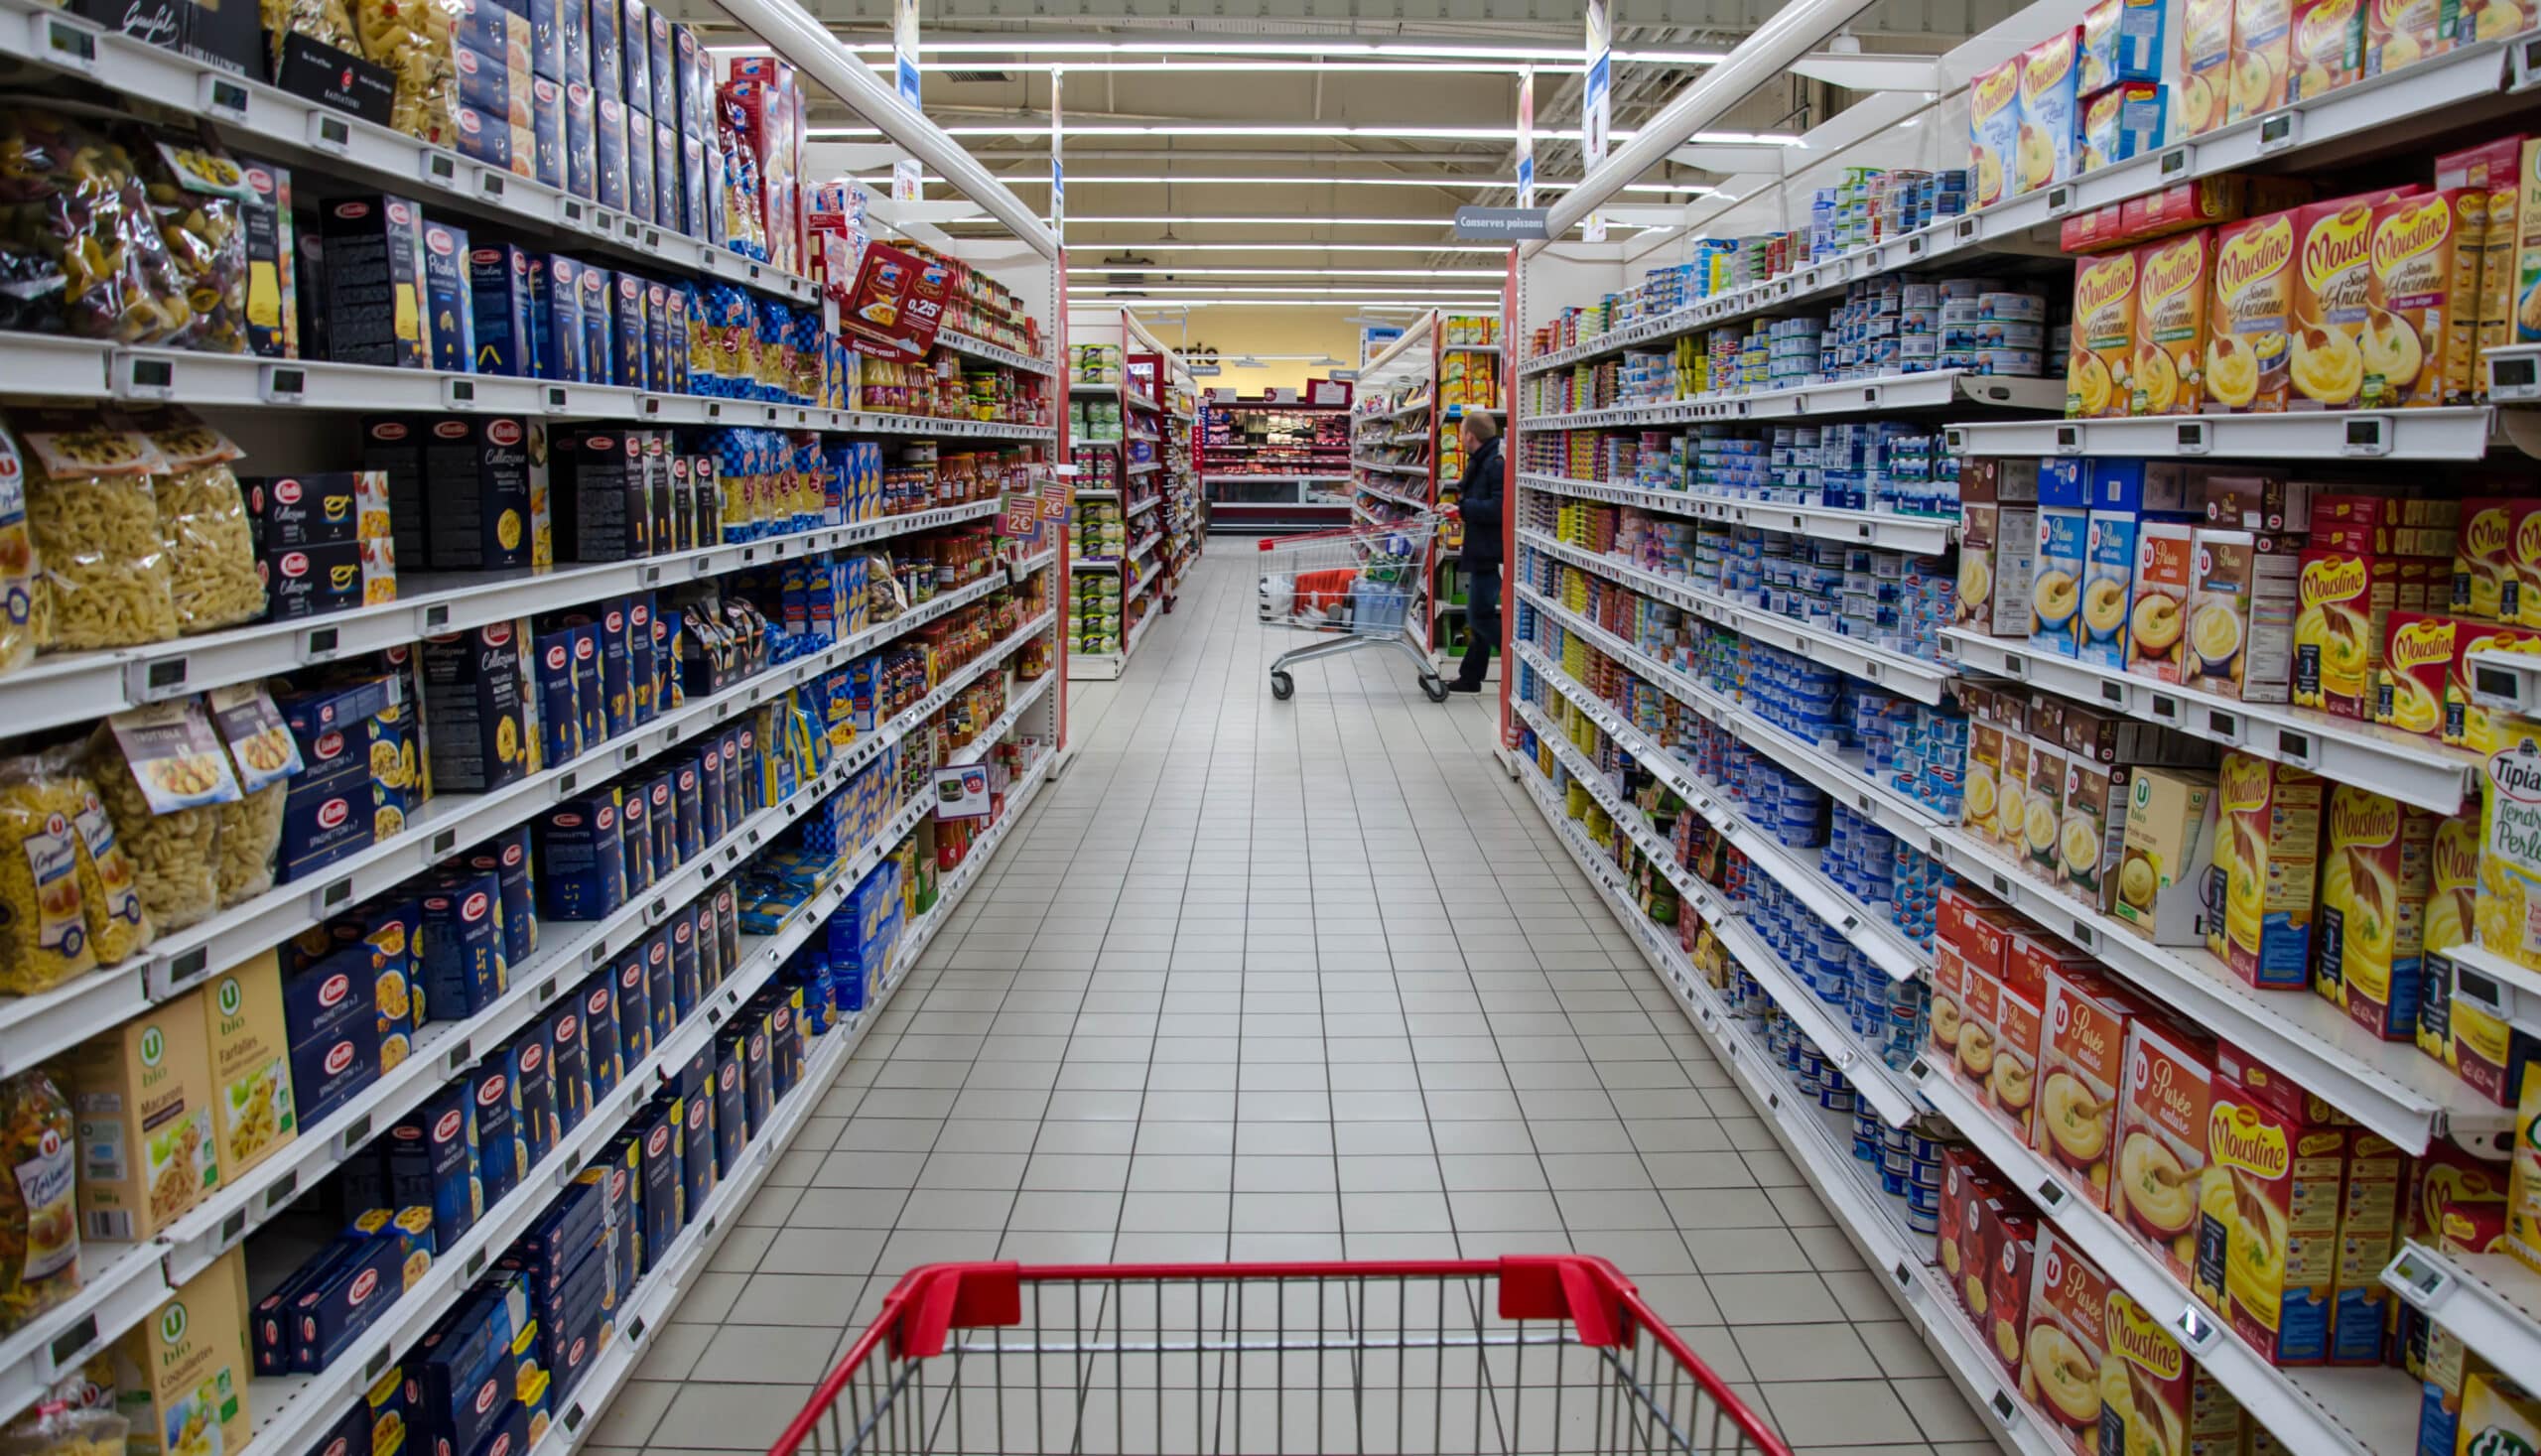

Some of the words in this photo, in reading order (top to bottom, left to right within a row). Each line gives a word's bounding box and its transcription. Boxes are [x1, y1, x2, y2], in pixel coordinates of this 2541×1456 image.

[1460, 216, 1505, 229] Conserves
[1506, 216, 1543, 230] poissons
[2375, 212, 2448, 269] Mousline
[2220, 233, 2289, 292] Mousline
[2307, 219, 2370, 279] Mousl
[2077, 265, 2133, 315] Mousline
[2144, 251, 2199, 304] Mousline
[1008, 515, 1033, 531] 2€
[1043, 500, 1063, 516] 2€
[2302, 569, 2363, 605] Mousline
[2221, 764, 2267, 805] Mousline
[2496, 756, 2541, 791] Tipia
[2333, 801, 2397, 841] Mousline
[2499, 798, 2541, 830] Tendr
[2496, 820, 2541, 860] Perle
[221, 1019, 244, 1036] bio
[2072, 1003, 2105, 1055] Purée
[2077, 1047, 2102, 1072] nature
[2152, 1058, 2193, 1117] Purée
[2159, 1107, 2191, 1135] nature
[2211, 1115, 2285, 1171] Mousline
[2066, 1262, 2102, 1322] Purée
[2072, 1307, 2100, 1338] nature
[2107, 1304, 2180, 1372] Mousline
